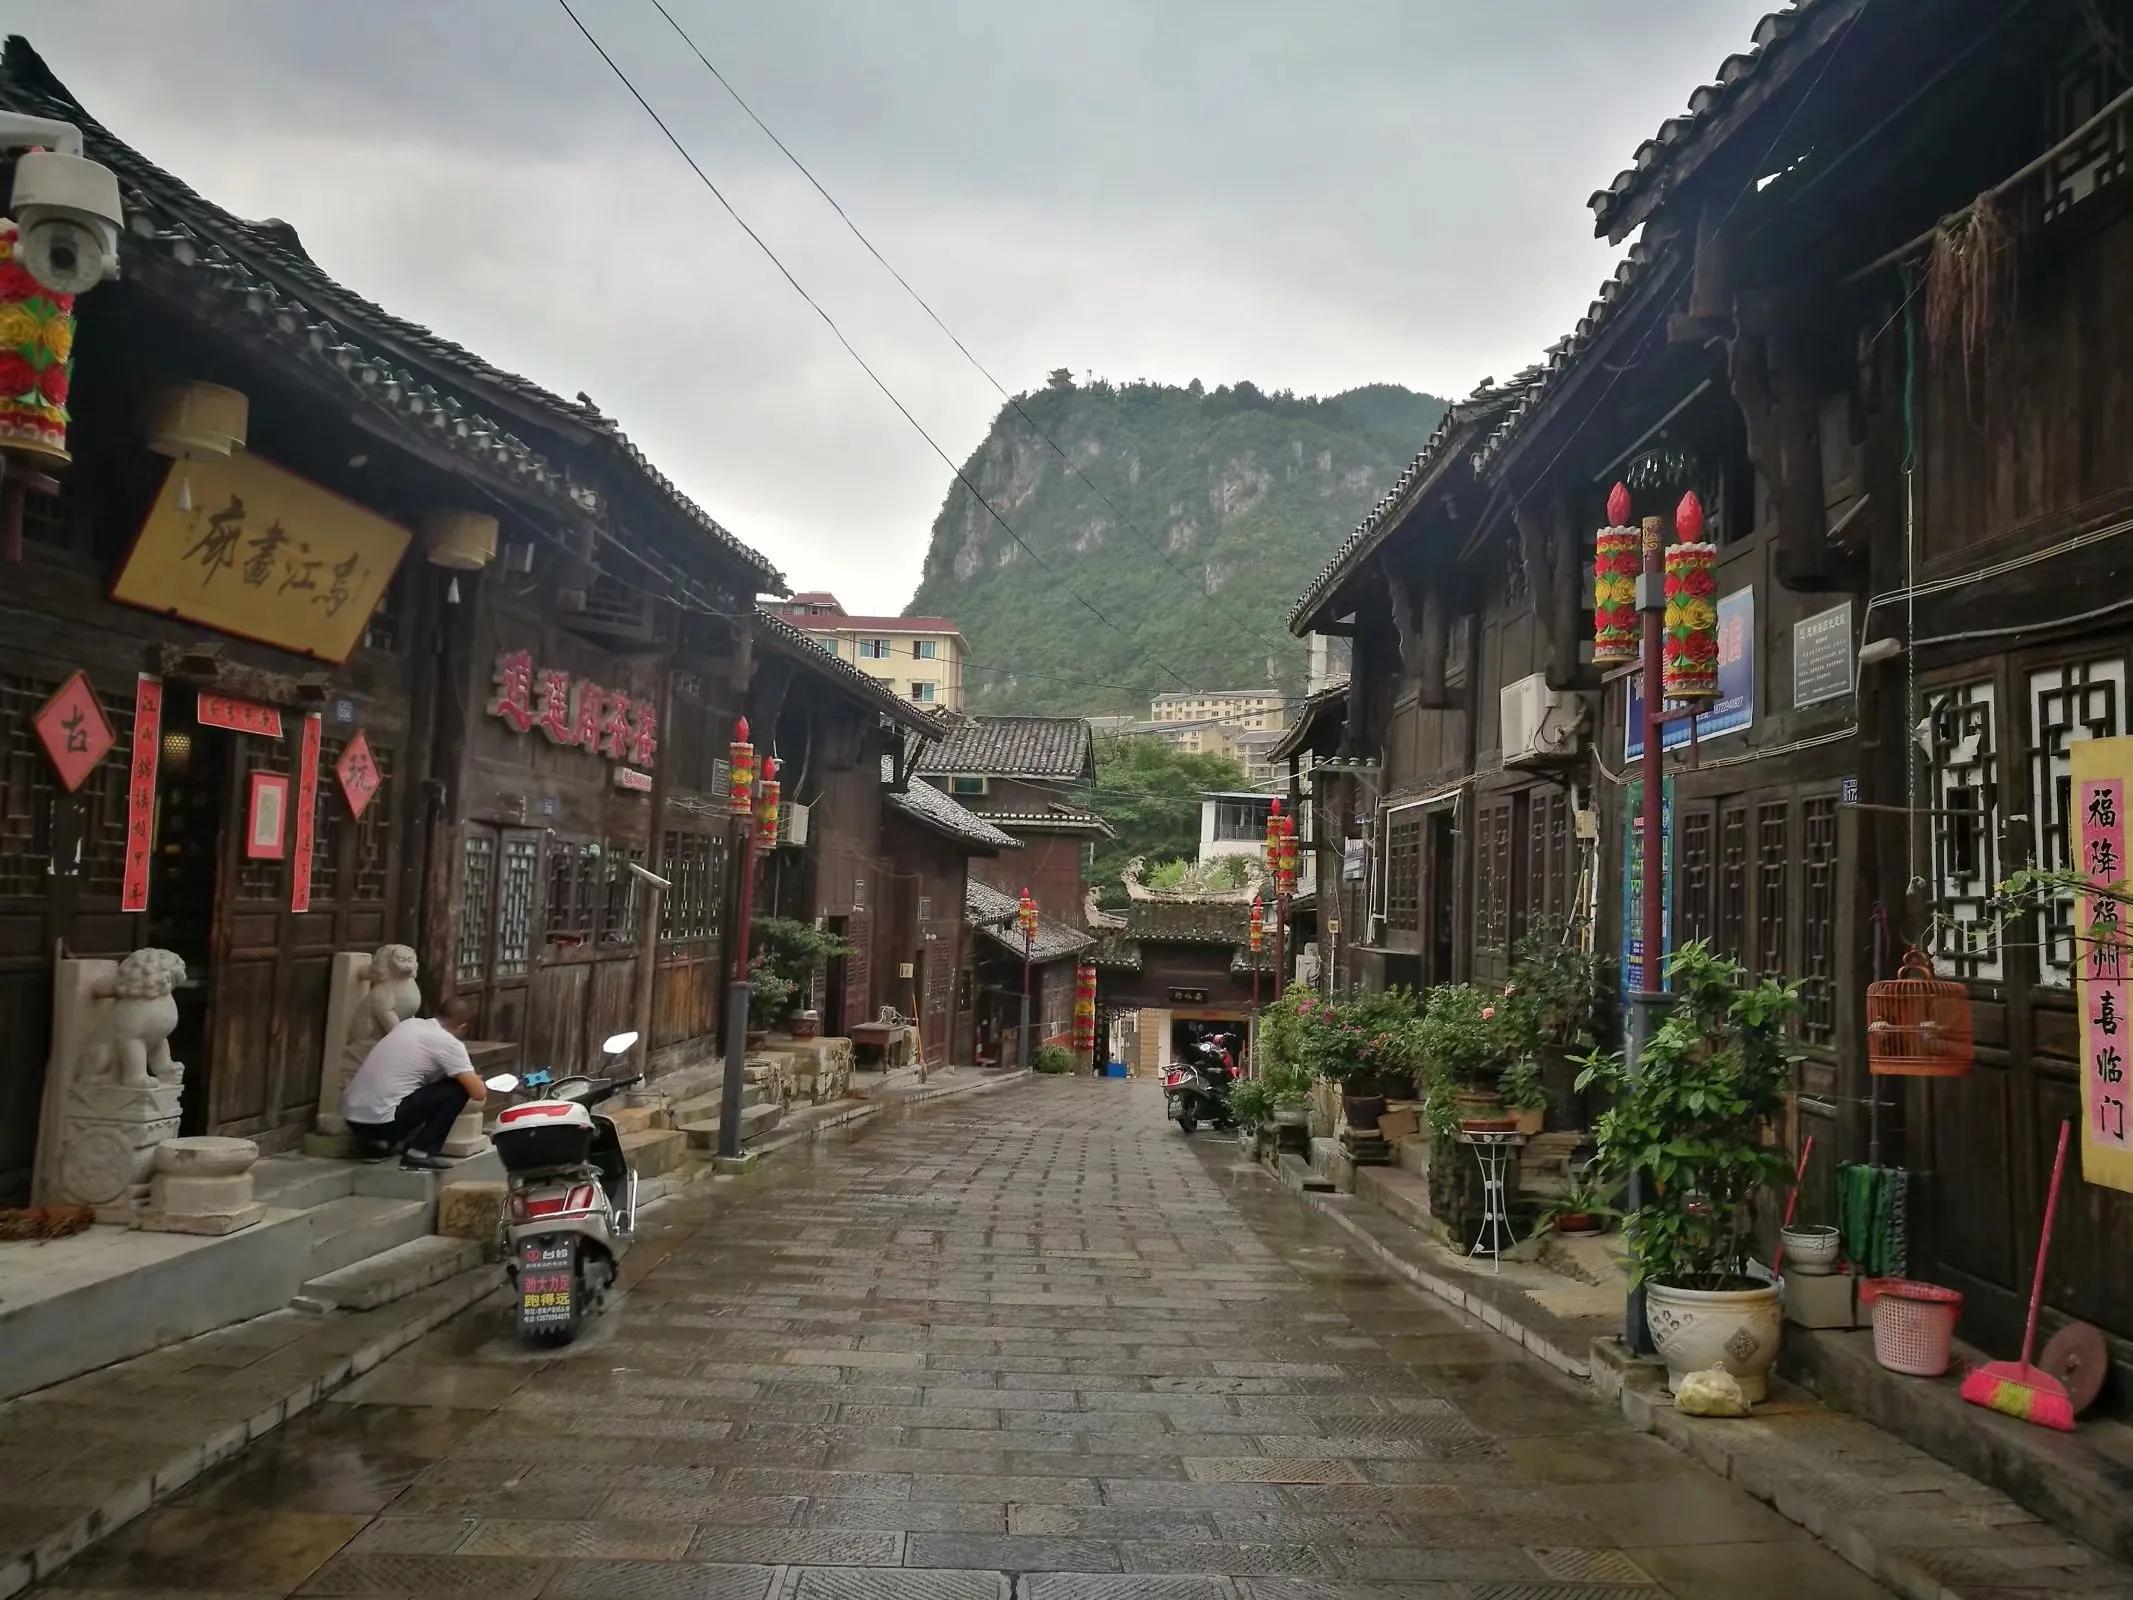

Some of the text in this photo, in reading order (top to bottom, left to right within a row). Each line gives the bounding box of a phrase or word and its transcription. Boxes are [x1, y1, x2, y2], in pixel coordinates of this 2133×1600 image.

[61, 704, 88, 753] 古
[524, 1292, 570, 1308] 跑得远
